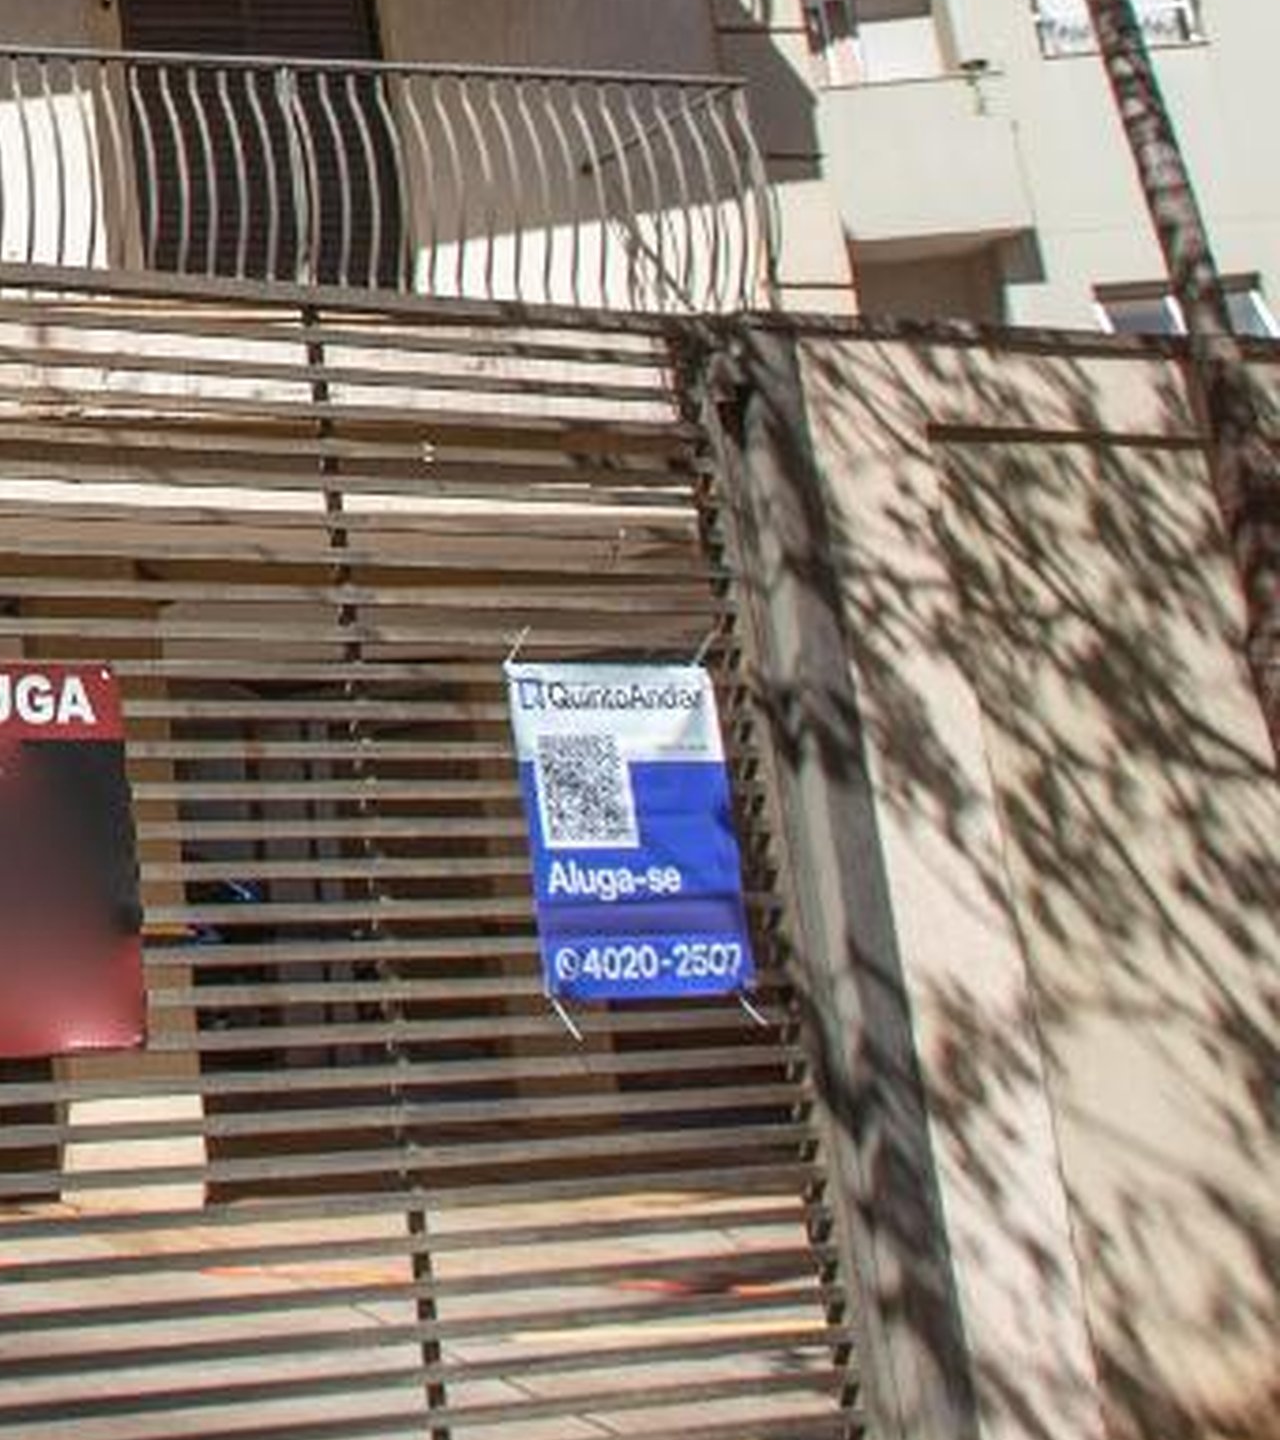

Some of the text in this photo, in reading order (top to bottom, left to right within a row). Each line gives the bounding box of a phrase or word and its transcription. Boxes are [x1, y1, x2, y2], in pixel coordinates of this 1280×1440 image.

[547, 682, 703, 711] QuintoAndar
[549, 861, 682, 901] Aluga-se
[584, 943, 742, 980] 4020-2507
